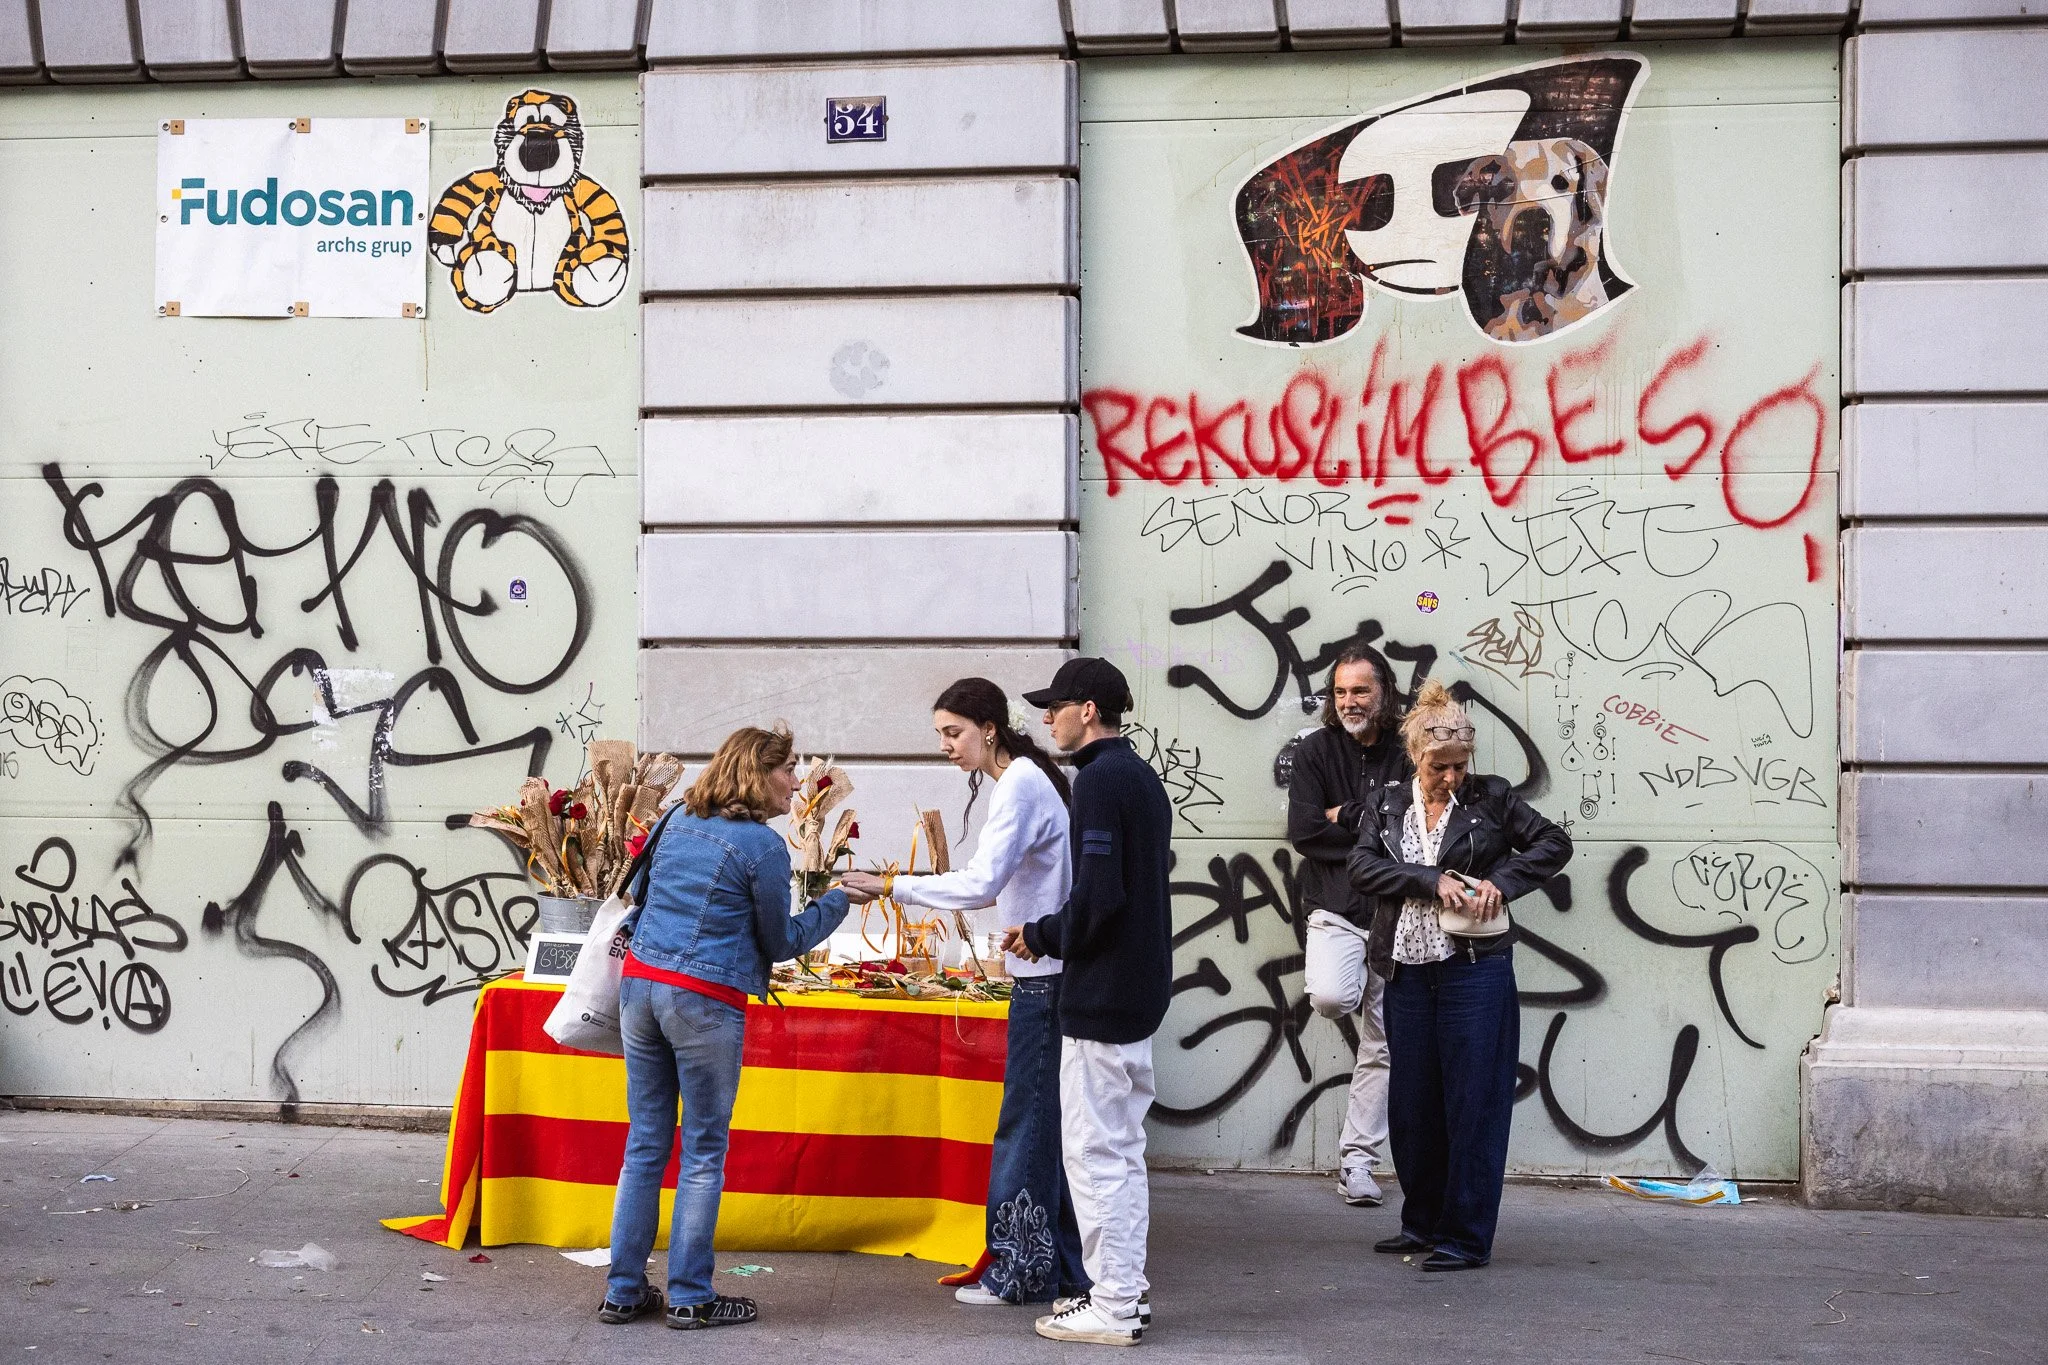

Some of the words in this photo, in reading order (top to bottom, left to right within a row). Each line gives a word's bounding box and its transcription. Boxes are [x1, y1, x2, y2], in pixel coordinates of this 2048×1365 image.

[833, 103, 879, 136] 54
[179, 177, 414, 226] Fudosan
[316, 236, 366, 253] archs
[371, 239, 412, 257] grup
[1141, 486, 1377, 552] SEÑOR
[1275, 537, 1407, 574] VINO
